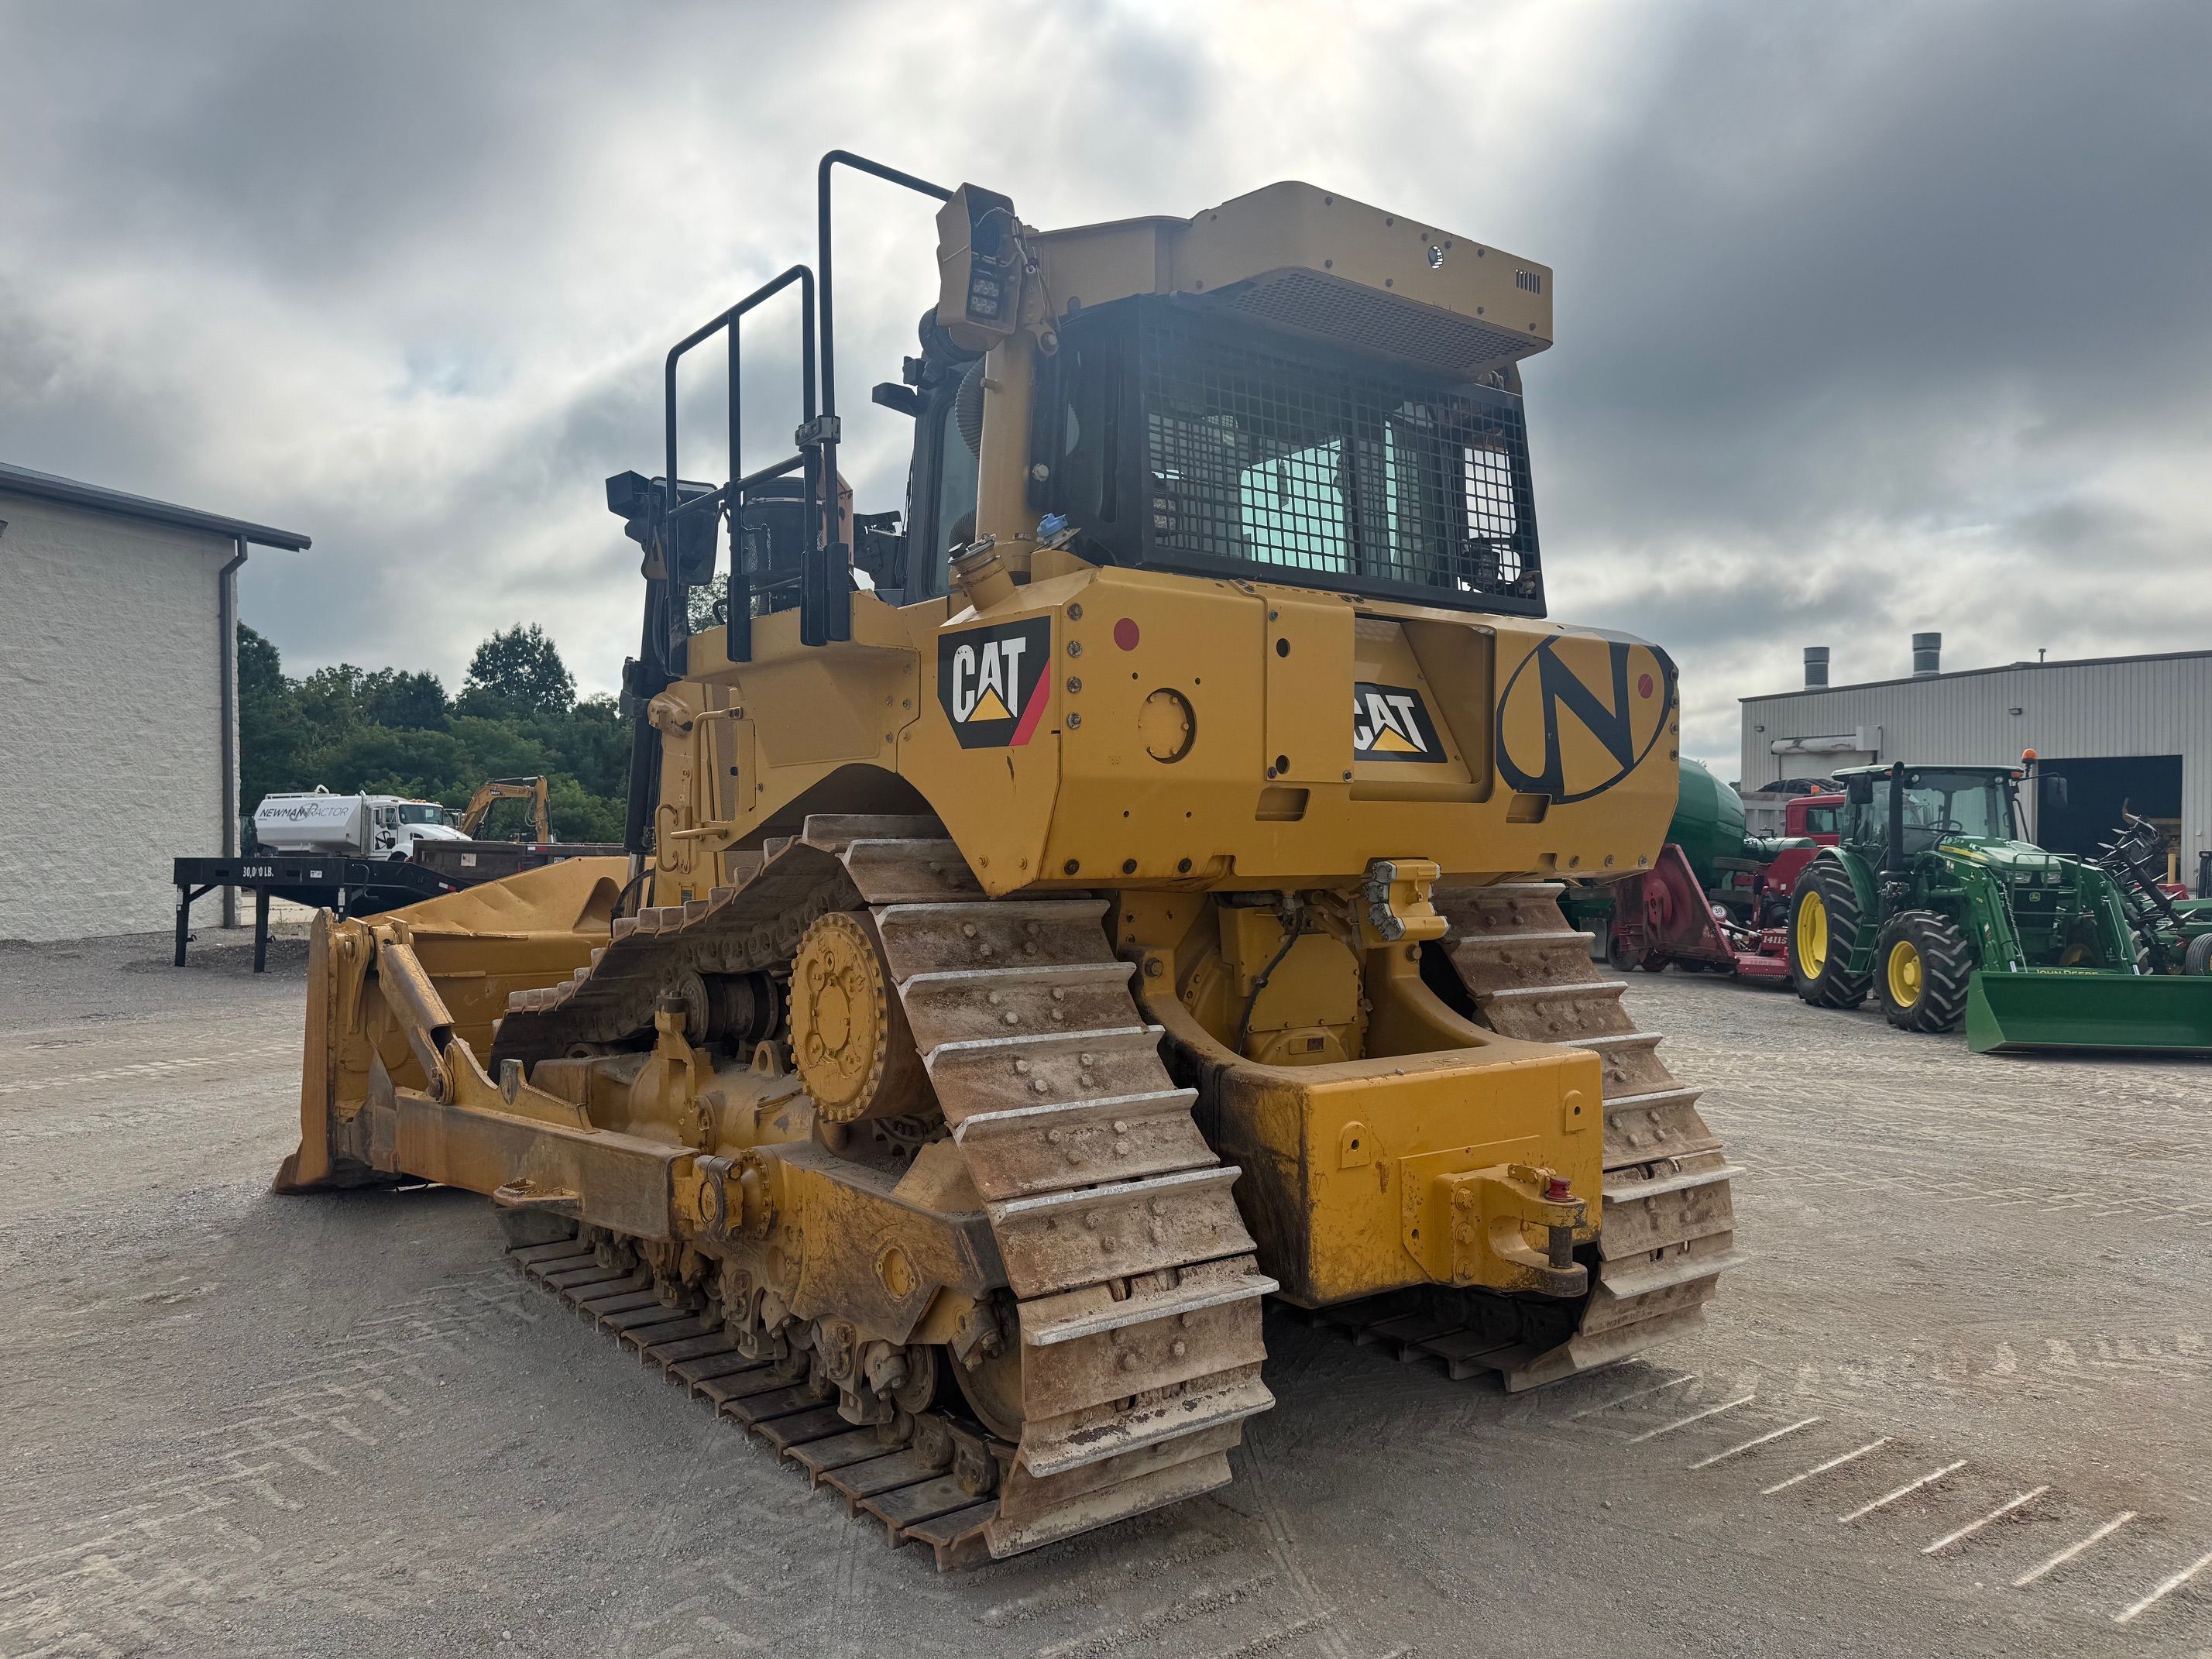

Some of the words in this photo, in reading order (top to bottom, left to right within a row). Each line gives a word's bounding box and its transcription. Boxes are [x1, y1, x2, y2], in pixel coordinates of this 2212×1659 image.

[953, 637, 1026, 723] CAT
[259, 808, 305, 817] NEWMAN
[306, 807, 349, 817] TRACTOR
[264, 866, 274, 877] LB.
